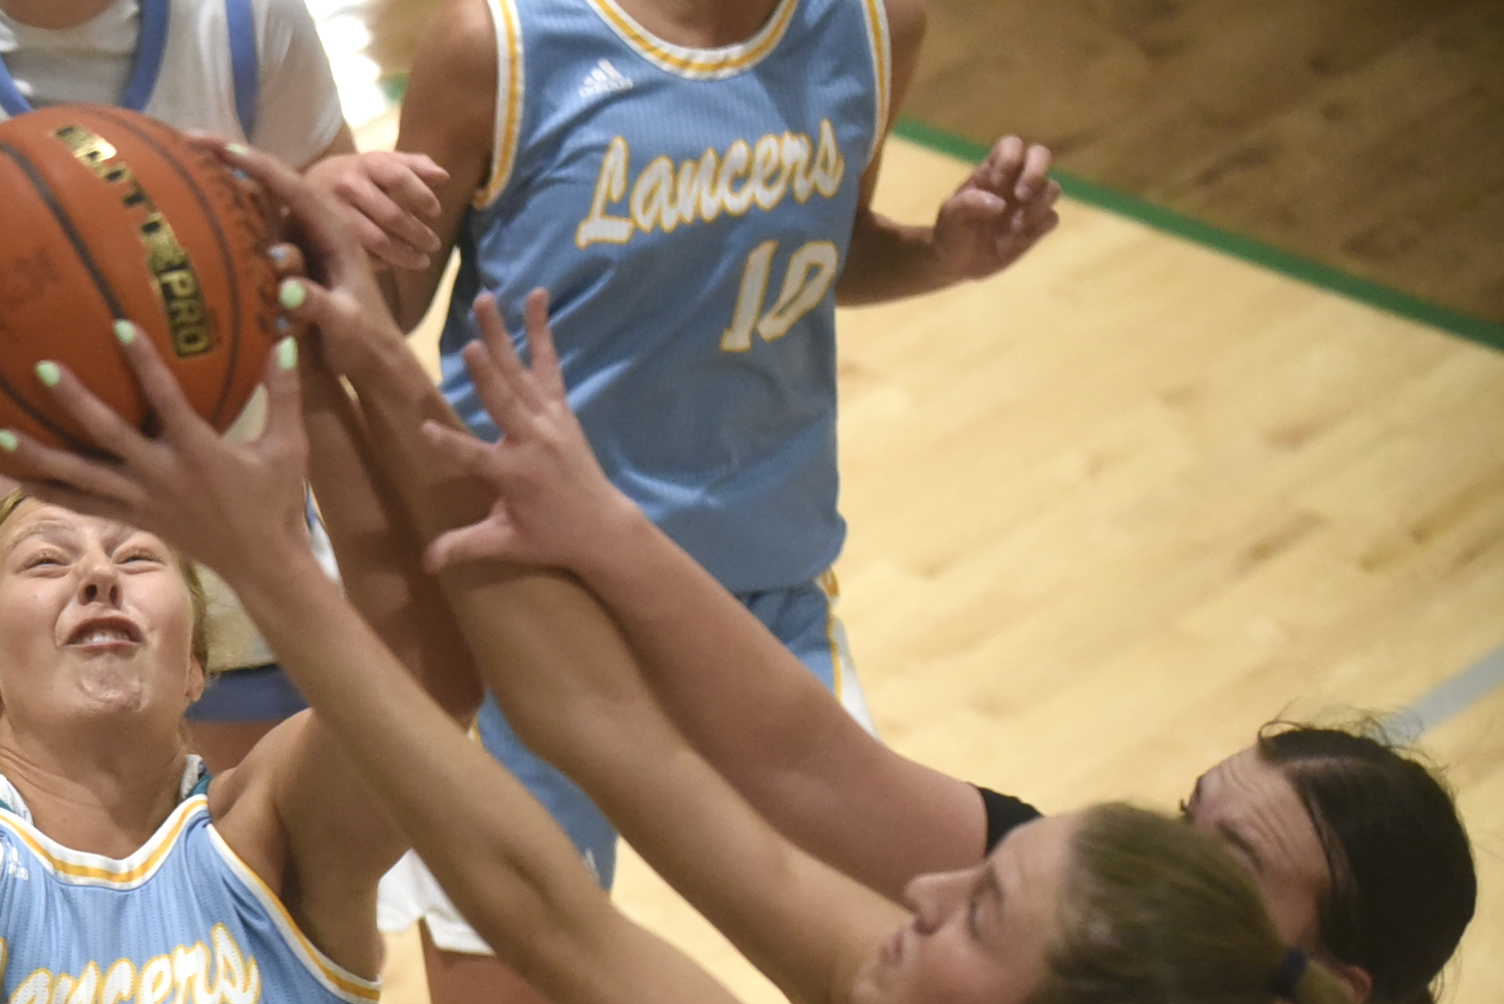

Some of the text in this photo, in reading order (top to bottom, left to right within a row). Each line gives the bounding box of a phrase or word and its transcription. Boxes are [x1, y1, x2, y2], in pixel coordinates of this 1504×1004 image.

[575, 118, 845, 250] Lancers
[157, 268, 212, 356] PRO
[719, 239, 840, 353] 10
